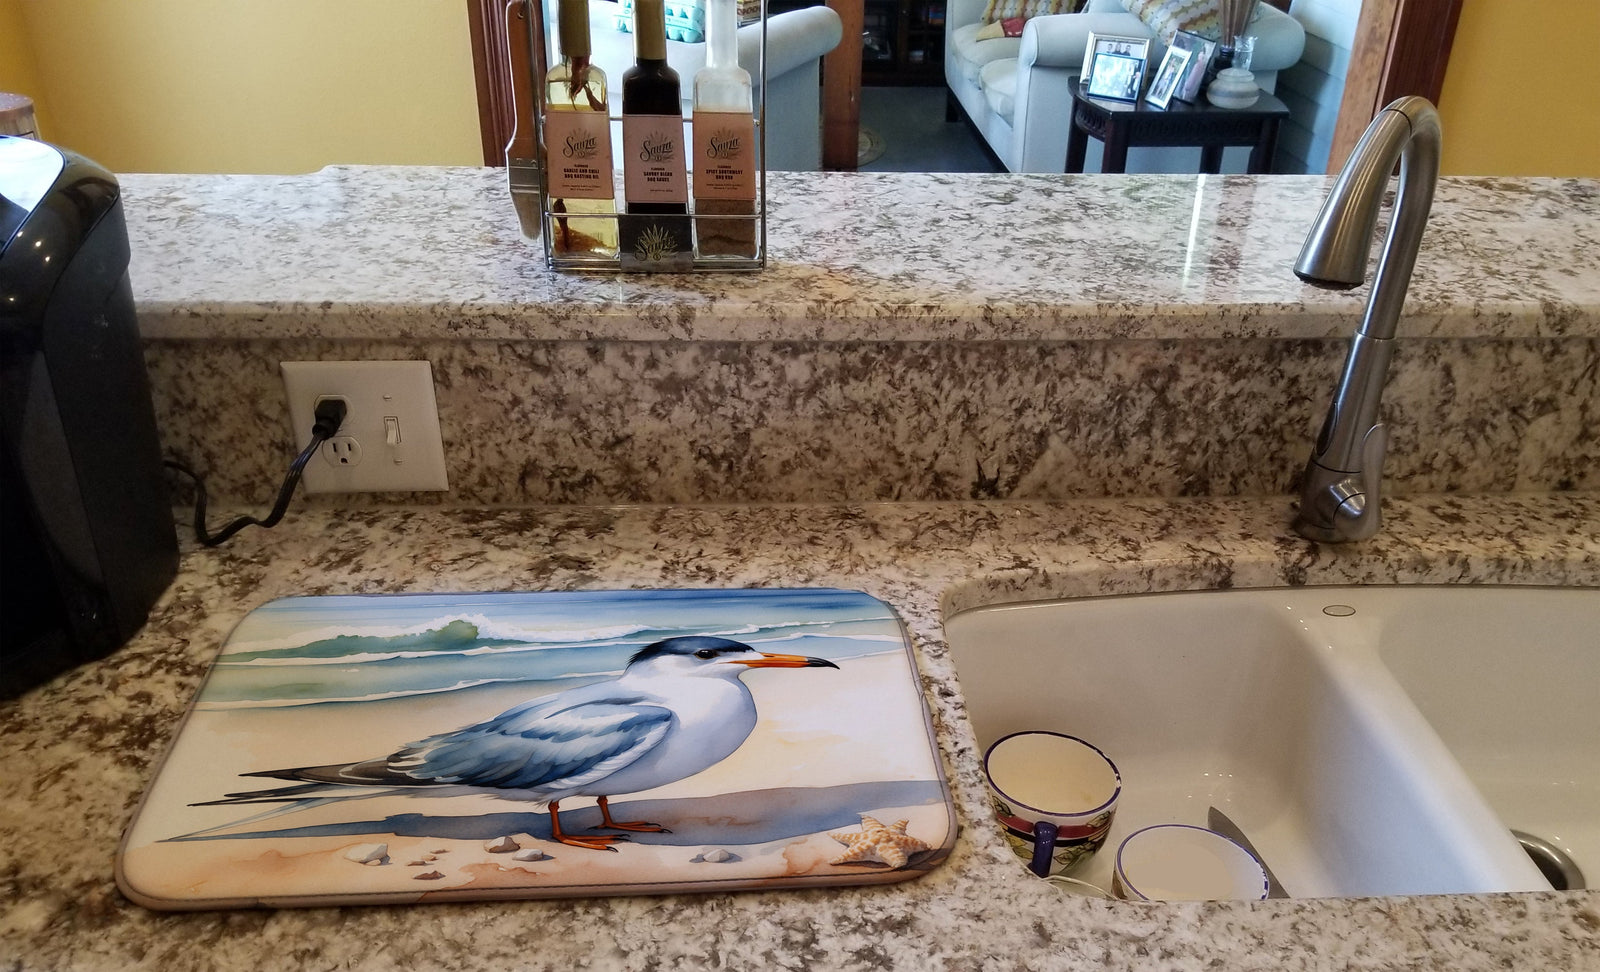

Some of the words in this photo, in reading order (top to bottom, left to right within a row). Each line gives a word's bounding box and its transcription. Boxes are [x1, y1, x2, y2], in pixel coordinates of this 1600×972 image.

[563, 136, 598, 158] Sauza
[640, 140, 674, 161] Sauza
[707, 137, 741, 158] Sauza
